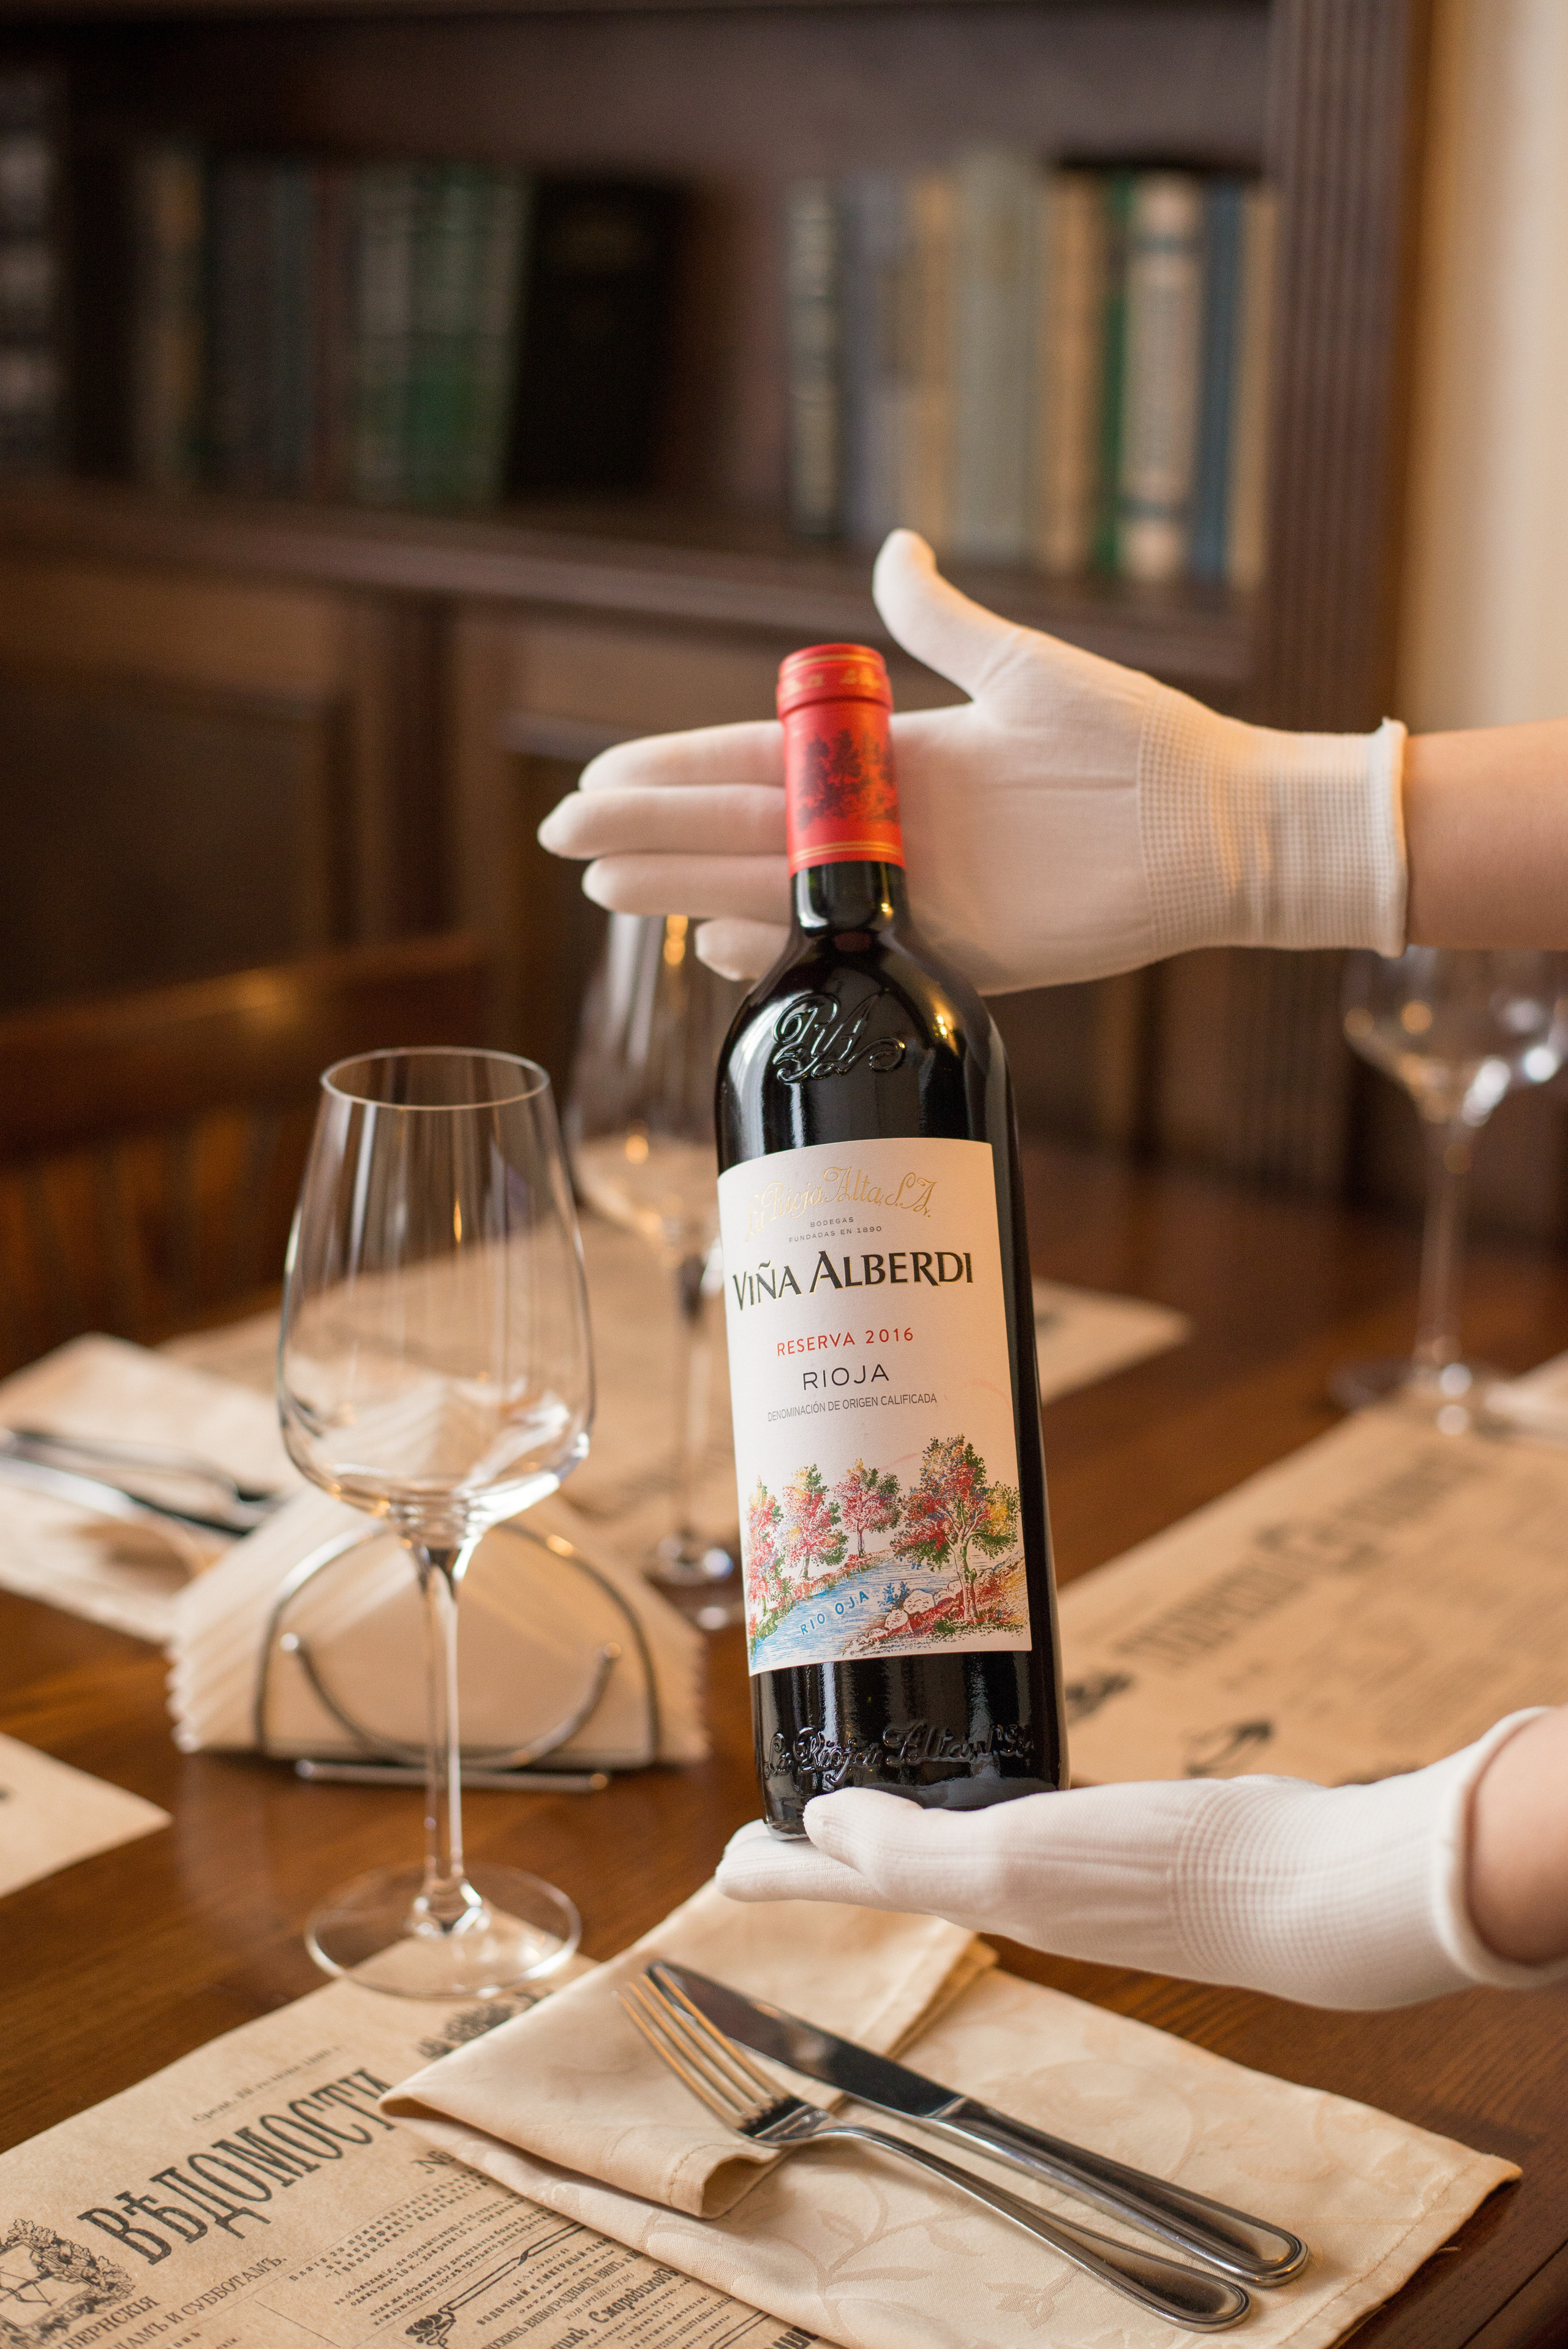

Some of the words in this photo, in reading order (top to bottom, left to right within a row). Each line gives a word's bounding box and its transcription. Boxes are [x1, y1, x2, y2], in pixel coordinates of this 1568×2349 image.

[762, 1181, 823, 1223] Rioja
[789, 1230, 835, 1243] FUNDADAS
[810, 1217, 854, 1228] BODEGAS
[733, 1260, 802, 1311] VIÑA
[809, 1250, 974, 1294] ALBERDI
[777, 1332, 856, 1357] RESERVA
[865, 1327, 914, 1345] 2016
[802, 1364, 889, 1390] RIOJA
[767, 1401, 826, 1422] DENOMINACIÓN
[827, 1401, 840, 1412] DE
[842, 1396, 878, 1410] ORIGEN
[880, 1393, 938, 1406] CALIFICADA
[800, 1613, 825, 1635] RIO
[835, 1591, 869, 1615] OJA
[476, 2288, 530, 2326] ВОДОЧНЫЙ
[586, 2234, 616, 2252] ЗАВО
[522, 2277, 600, 2328] ВИНОГРАДНЫХЪ
[593, 2260, 625, 2280] ВИНЪ
[617, 2317, 653, 2342] Телефонъ
